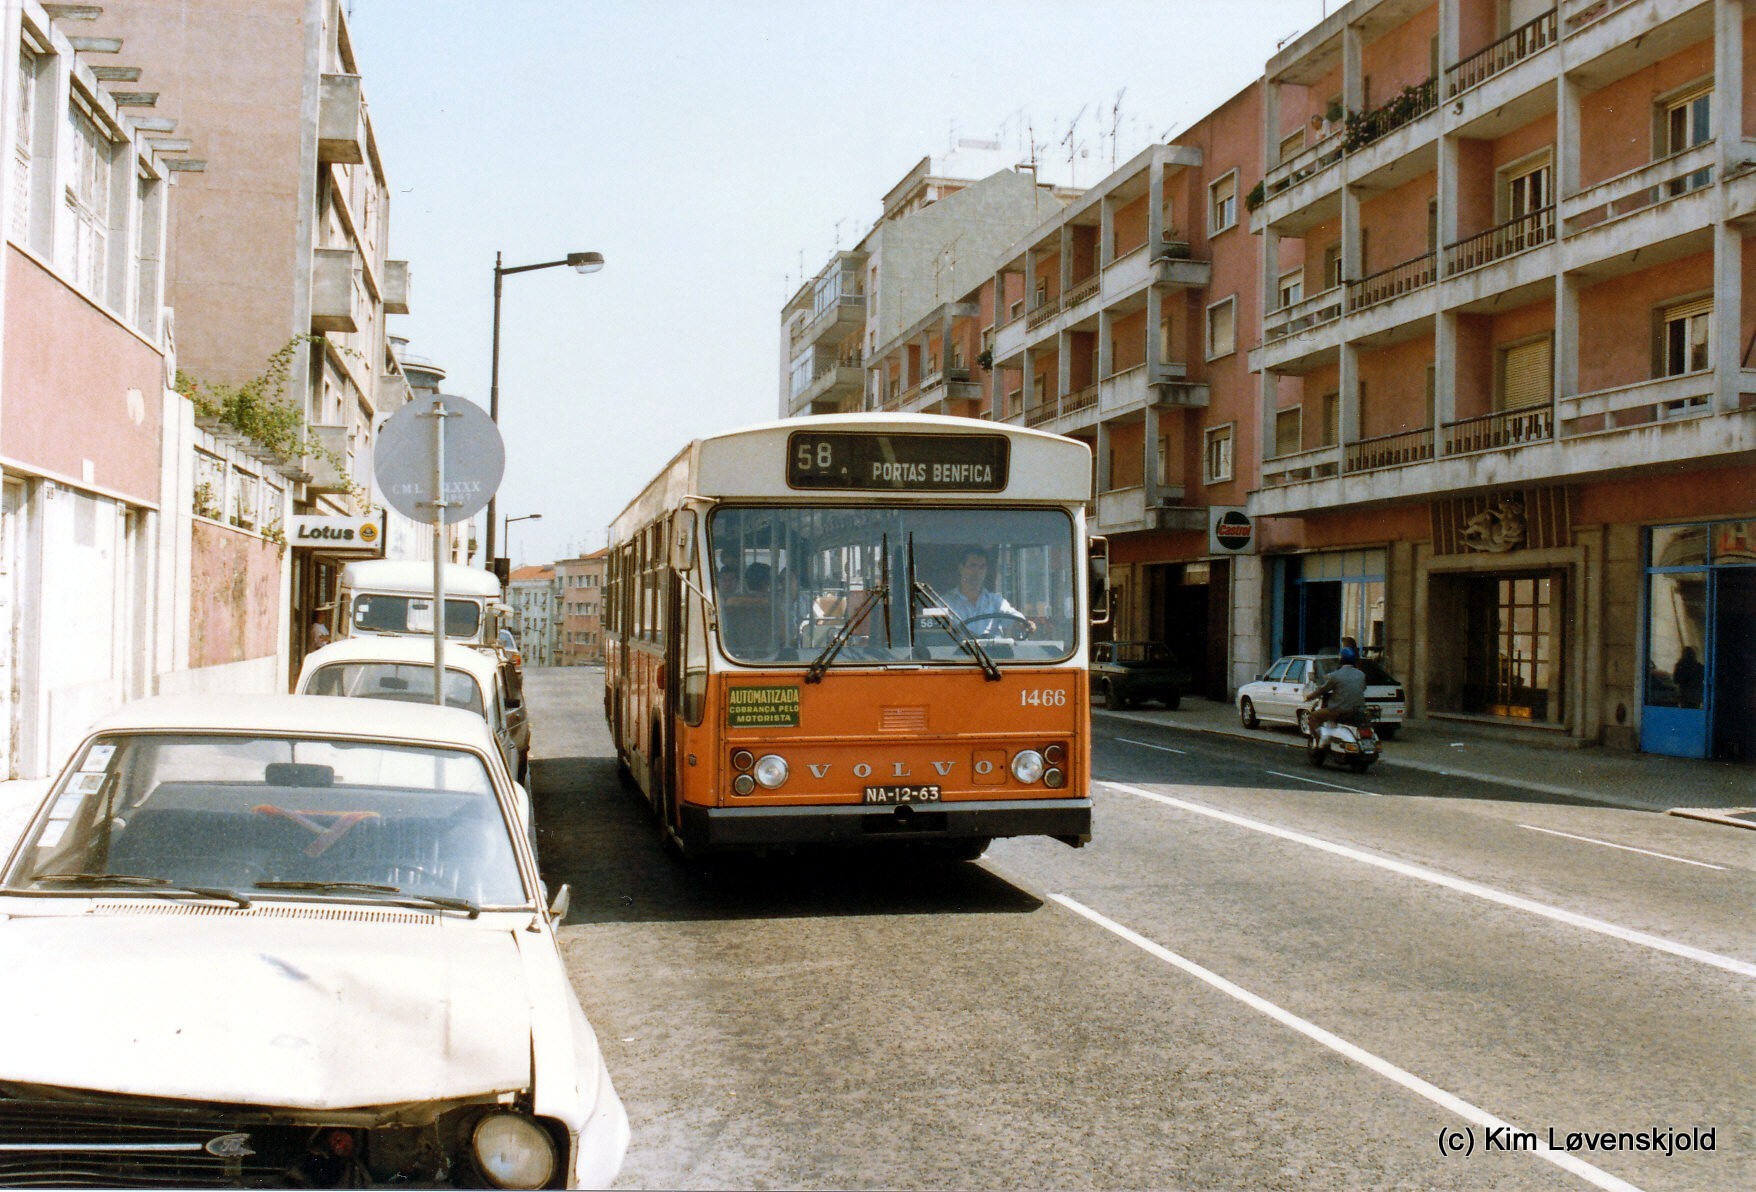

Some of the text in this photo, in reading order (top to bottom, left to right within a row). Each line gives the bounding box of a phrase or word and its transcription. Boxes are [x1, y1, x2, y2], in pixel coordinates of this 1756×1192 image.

[798, 443, 831, 470] 58
[873, 462, 992, 482] PORTAS BENFICA
[298, 524, 354, 540] Lotus
[1218, 524, 1251, 536] Castrol
[729, 689, 799, 704] AUTOMATIZADA
[1021, 689, 1066, 706] 1466
[778, 704, 799, 713] PELO
[736, 714, 791, 722] MOTORISTA
[807, 761, 993, 778] VOLVO
[866, 786, 939, 802] NA-12-63
